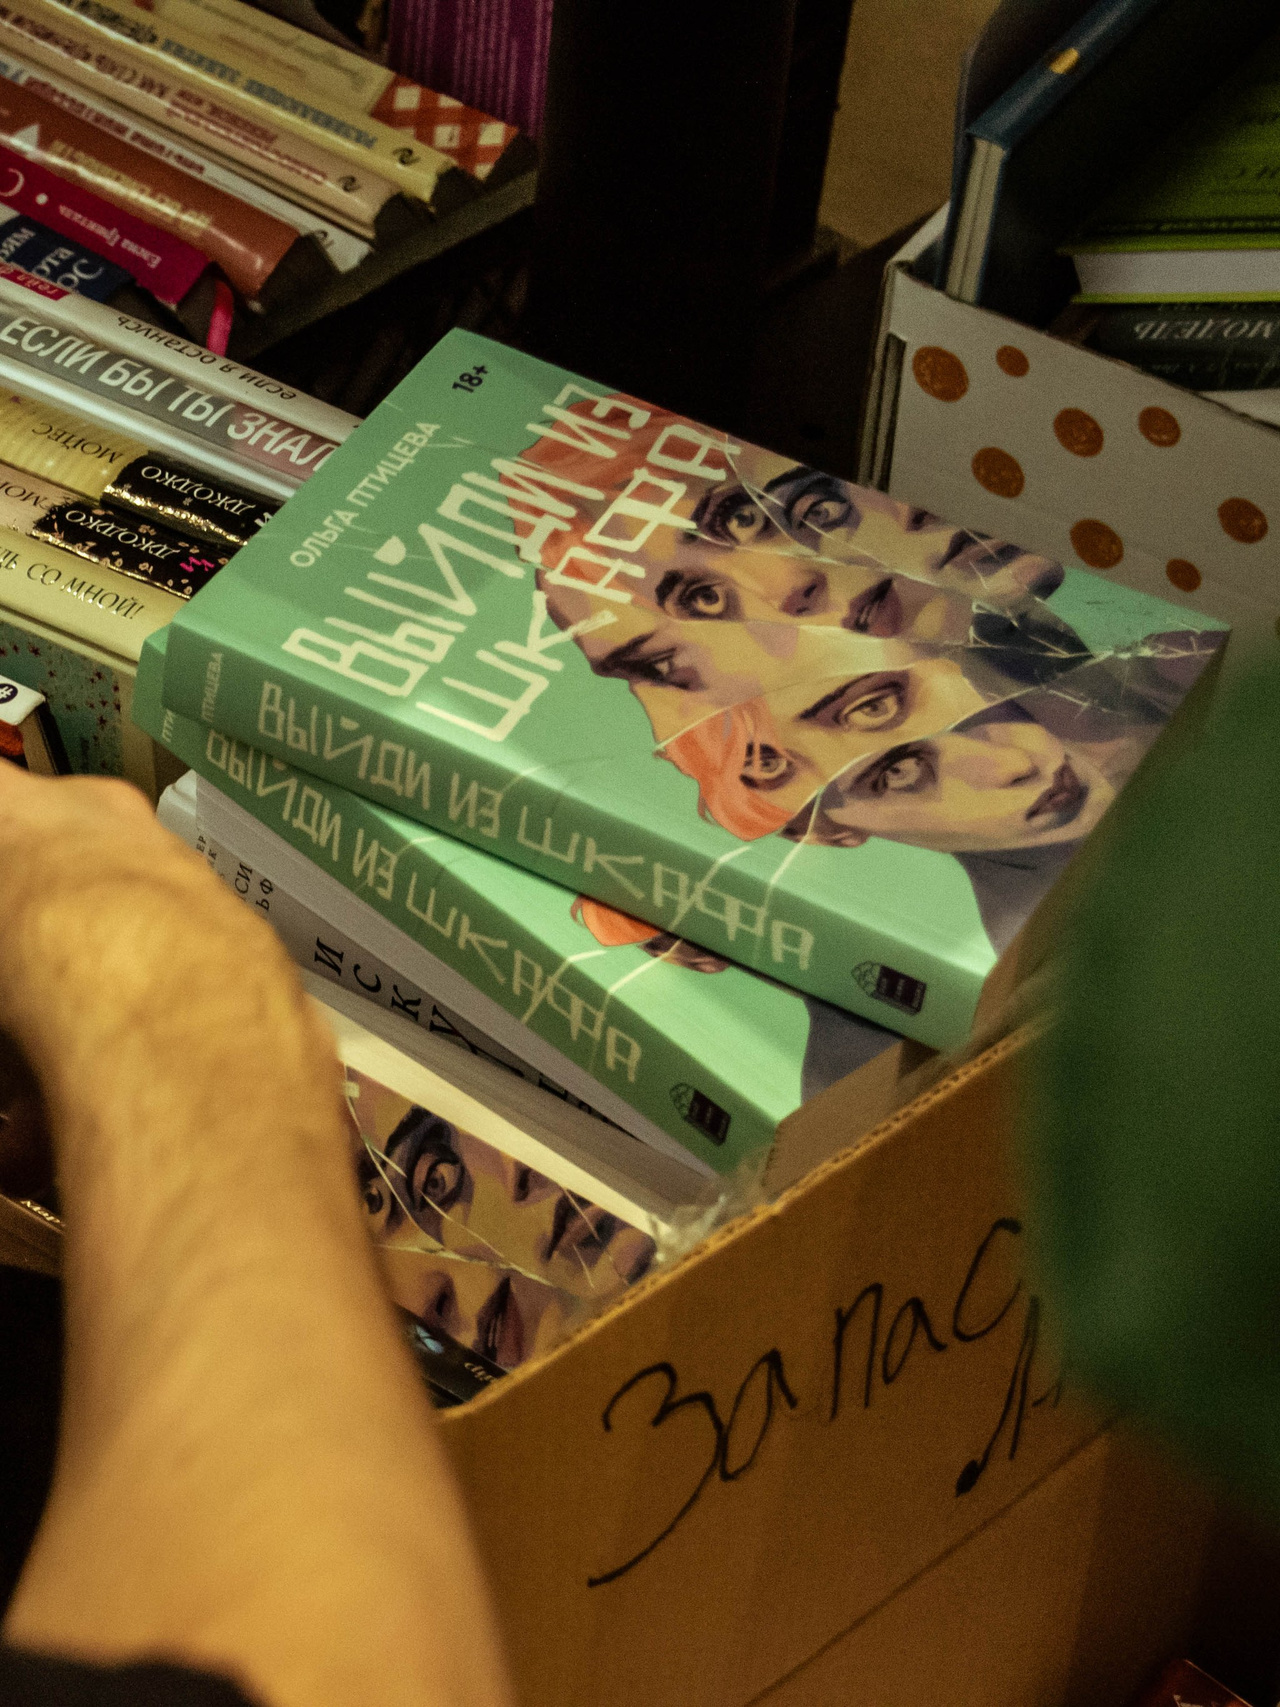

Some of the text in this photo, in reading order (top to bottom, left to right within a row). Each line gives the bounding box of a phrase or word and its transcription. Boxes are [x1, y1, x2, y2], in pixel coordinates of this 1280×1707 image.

[98, 357, 172, 402] БЫ
[170, 381, 235, 431] ТЫ
[225, 404, 340, 474] ЗНАЛ
[115, 314, 298, 403] если я останусь
[452, 363, 490, 394] 18+
[31, 420, 256, 516] ДЖОДЖО МОЙЕС
[289, 420, 442, 568] ОЛЬГА ПТИЦЕВА
[25, 561, 64, 588] СО
[57, 570, 148, 622] МНОЙ!
[62, 507, 183, 562] ДЖОДЖО
[281, 382, 651, 697] ВЫЙДИ ИЗ
[415, 424, 742, 742] ШКАФА
[258, 680, 816, 972] ВЫЙДИ ИЗ ШКАФА
[352, 827, 396, 900] ИЗ
[406, 874, 643, 1083] ШКАФА
